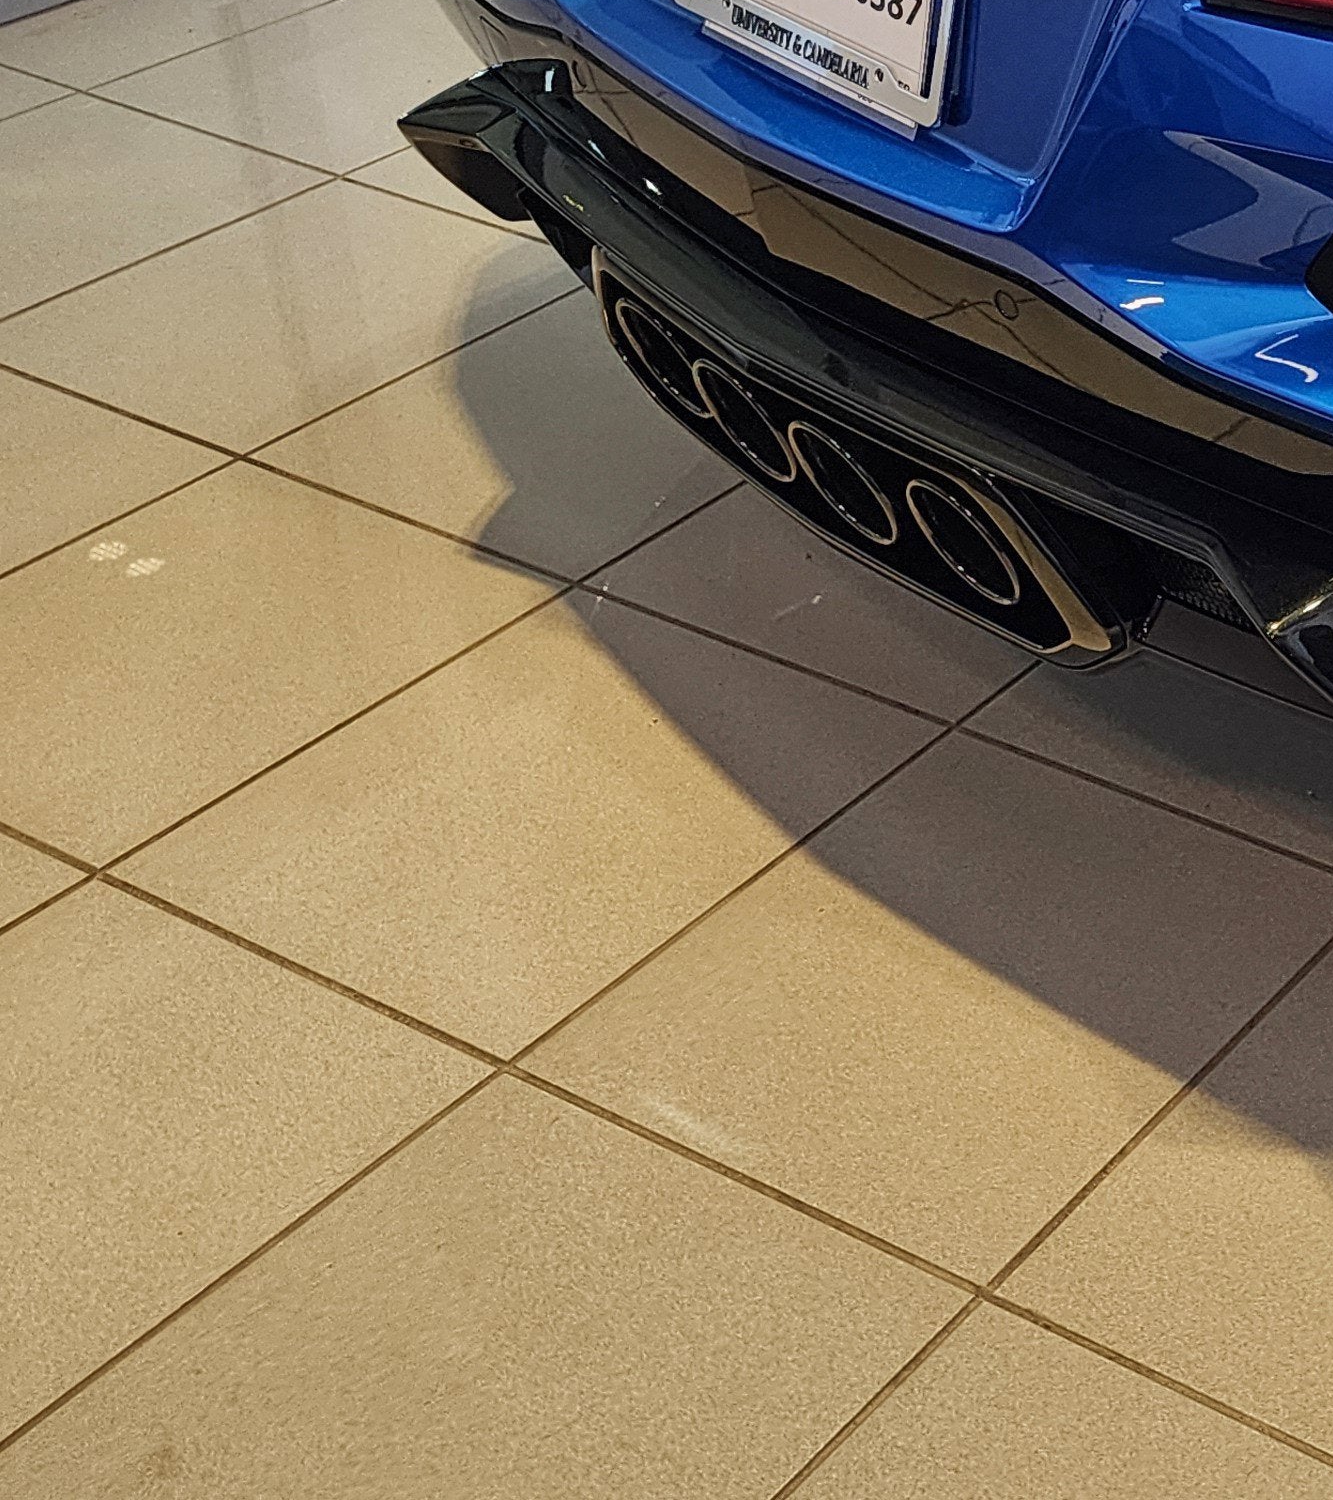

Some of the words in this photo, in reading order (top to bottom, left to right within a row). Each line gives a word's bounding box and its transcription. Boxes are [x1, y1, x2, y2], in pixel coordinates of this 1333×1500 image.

[731, 3, 794, 50] UNIVERSITY
[793, 34, 802, 57] &
[802, 39, 870, 90] CANDELARIA
